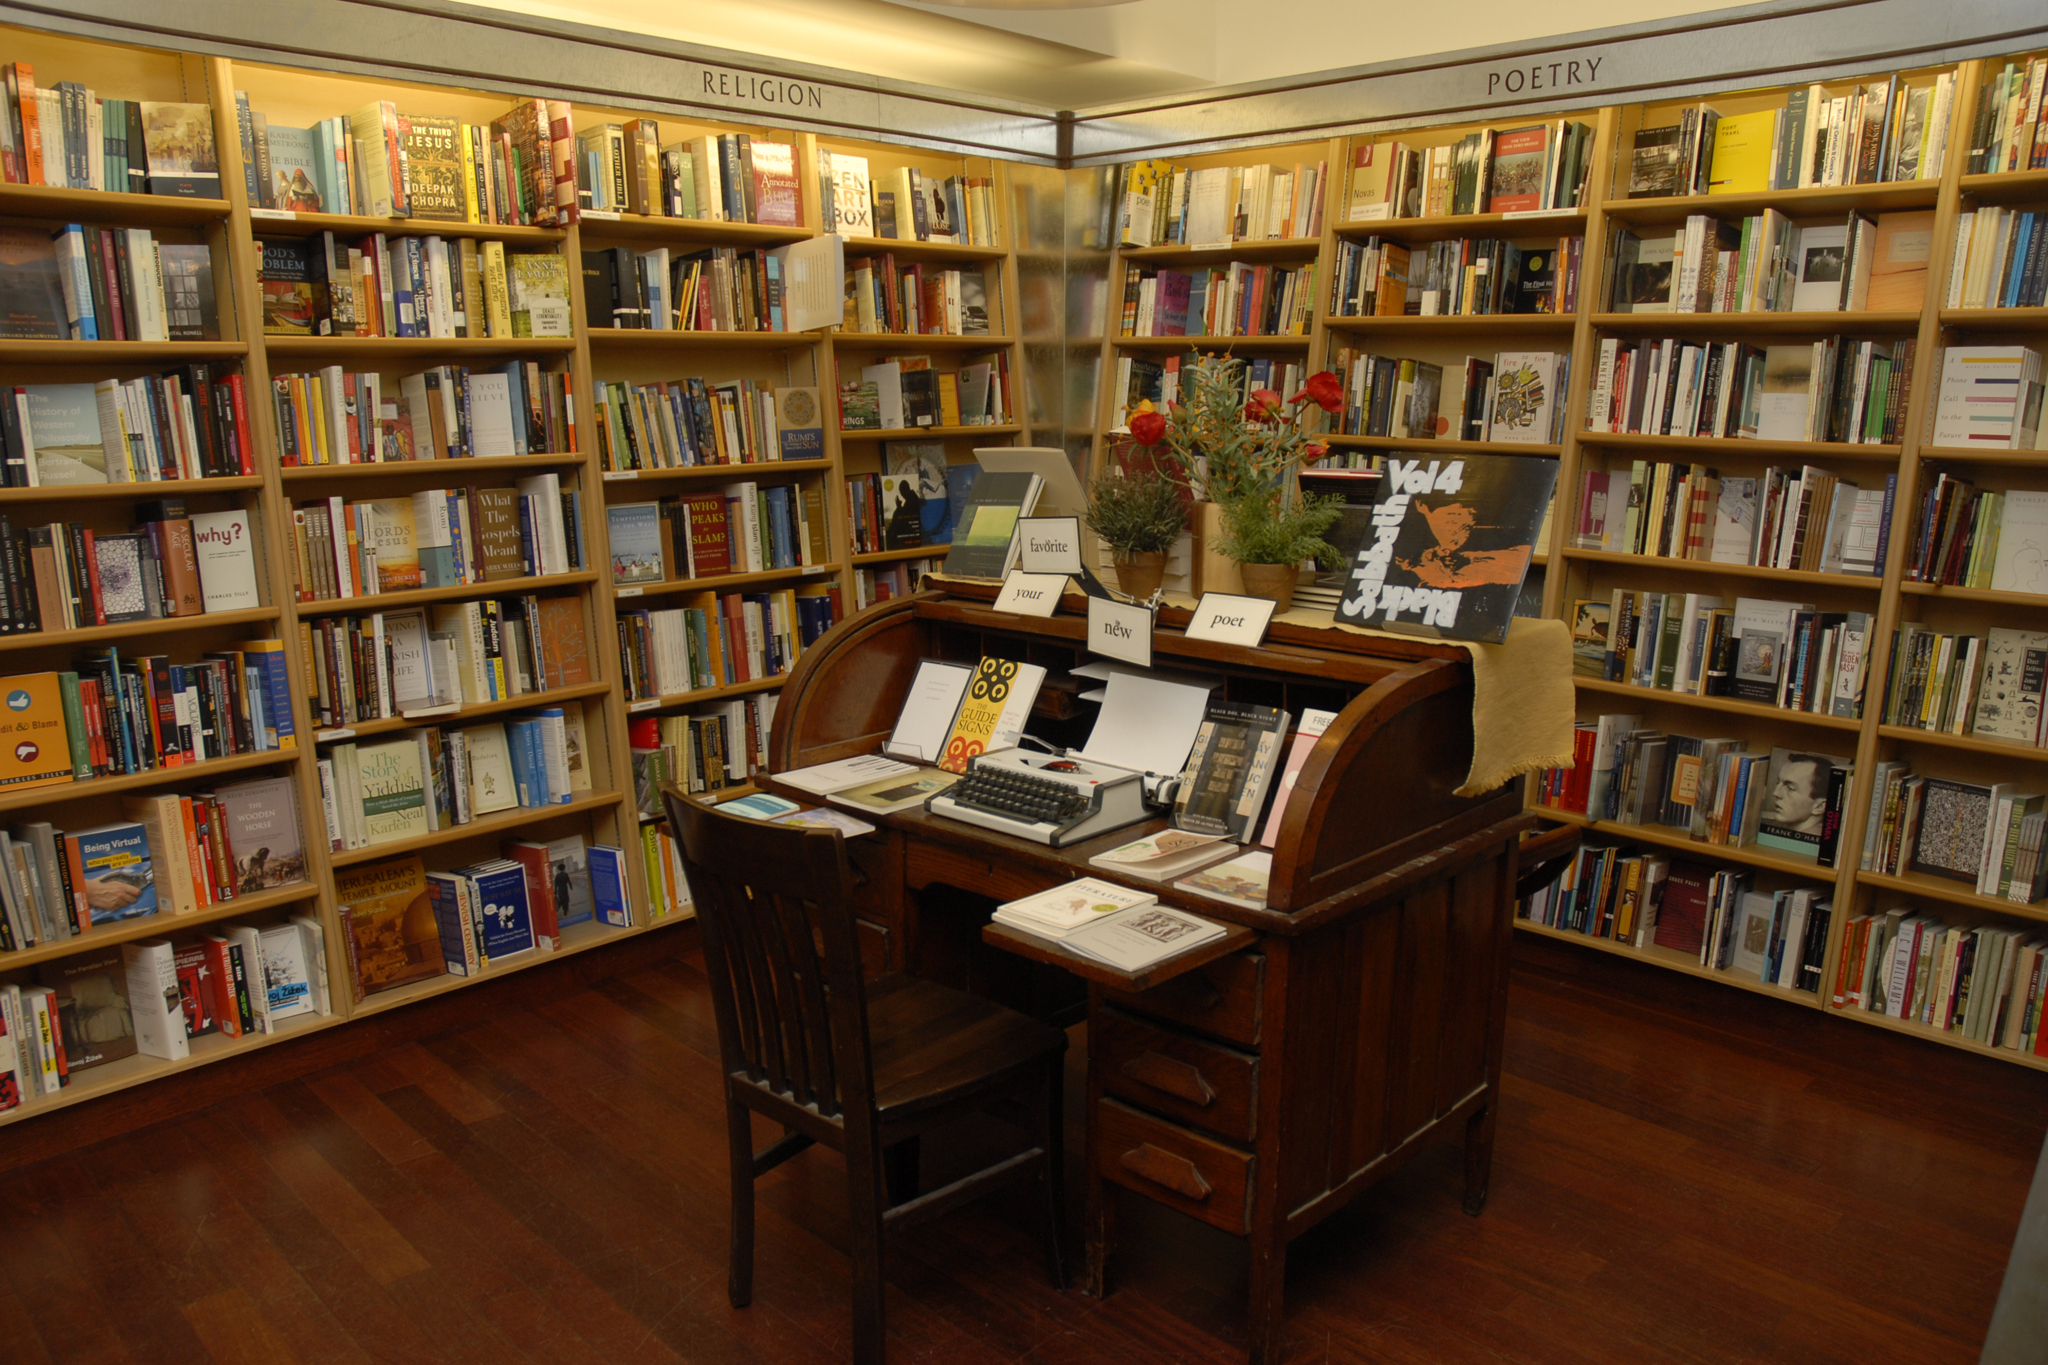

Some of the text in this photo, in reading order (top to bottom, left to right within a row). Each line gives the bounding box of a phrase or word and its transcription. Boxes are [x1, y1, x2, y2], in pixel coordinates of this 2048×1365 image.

[1487, 57, 1603, 96] POETRY
[703, 71, 822, 109] RELIGION
[2029, 85, 2042, 121] PHILLIPS
[30, 128, 39, 149] blank
[270, 131, 298, 140] KAREN
[412, 126, 452, 137] THE THIRD
[270, 139, 310, 149] MSTRONG
[407, 136, 452, 149] JESUS
[33, 150, 41, 168] slate
[257, 131, 269, 182] REVELATIONS
[270, 156, 312, 167] HE BIBLE
[1868, 139, 1878, 171] JORDAN
[614, 149, 624, 201] OTHER BIBLE
[761, 175, 799, 188] Annotated
[832, 169, 865, 189] ZEN
[412, 183, 455, 195] DEEPAK
[1353, 188, 1375, 198] Novas
[412, 195, 457, 207] CHOPRA
[834, 191, 866, 208] ART
[835, 208, 869, 227] BOX
[263, 259, 305, 270] OBLEM
[525, 262, 557, 270] ANNE
[1702, 229, 1716, 291] JANE KENYON
[517, 270, 566, 279] LAMOTT
[1503, 359, 1518, 367] fire
[1534, 355, 1547, 363] fire
[1598, 349, 1606, 391] KENNETH
[335, 369, 344, 407] ON GOD
[480, 382, 504, 391] YOU
[29, 394, 48, 403] The
[198, 384, 208, 406] SARTRE
[471, 393, 505, 402] LIEVE
[30, 406, 81, 417] History of
[32, 420, 74, 429] Western
[33, 433, 90, 444] Philosophy
[787, 432, 815, 441] RUMI'S
[802, 440, 819, 449] SUN
[38, 457, 82, 467] Bertrand
[39, 470, 76, 479] Russell
[1388, 459, 1465, 494] Vol 4
[480, 494, 511, 507] What
[691, 501, 718, 511] WHO
[1885, 489, 1894, 513] MERWIN
[485, 511, 509, 524] The
[611, 514, 655, 522] TEMPTATIONS
[691, 514, 725, 524] PEAKS
[196, 522, 243, 546] why?
[375, 525, 411, 538] ORDS
[481, 525, 521, 539] ospels
[171, 531, 181, 549] AGE
[375, 536, 409, 547] esus
[692, 533, 726, 545] SLAM?
[1030, 538, 1068, 553] favorite
[181, 534, 195, 572] SECULAR
[483, 545, 517, 557] Meant
[1342, 494, 1412, 619] Sabbath
[7, 549, 15, 571] DEFENSE
[1013, 587, 1044, 601] your
[385, 621, 416, 631] IVING
[1210, 614, 1246, 628] poet
[490, 619, 500, 652] Judaism
[1104, 622, 1132, 639] new
[395, 638, 403, 646] A
[391, 650, 420, 661] WISH
[190, 697, 200, 737] VOLTAIRE
[961, 708, 998, 725] GUIDE
[32, 718, 59, 731] Blame
[957, 720, 992, 735] SIGNS
[371, 751, 400, 768] The
[1, 770, 65, 785] HARLES TILLY
[361, 764, 412, 783] Story of
[364, 776, 421, 798] Yiddish
[1871, 771, 1883, 817] MESSENGER
[248, 802, 263, 810] THE
[395, 805, 425, 821] Neal
[237, 809, 276, 822] WOODEN
[245, 821, 273, 832] HORSE
[370, 819, 411, 835] Karlen
[649, 829, 657, 853] OSHO
[1767, 827, 1820, 843] FRANK O'HAR
[84, 835, 142, 854] Being Virtual
[112, 854, 130, 864] really
[120, 857, 140, 866] online
[60, 851, 69, 885] OUTSIDER
[338, 866, 416, 893] JERUSALEM'S
[1629, 864, 1638, 888] OVID
[340, 886, 377, 902] TEMPLE
[381, 878, 417, 893] MOUNT
[459, 893, 475, 966] JEWISH CENTURY
[1890, 960, 1906, 1005] WILLIAMS
[268, 989, 279, 1001] voj
